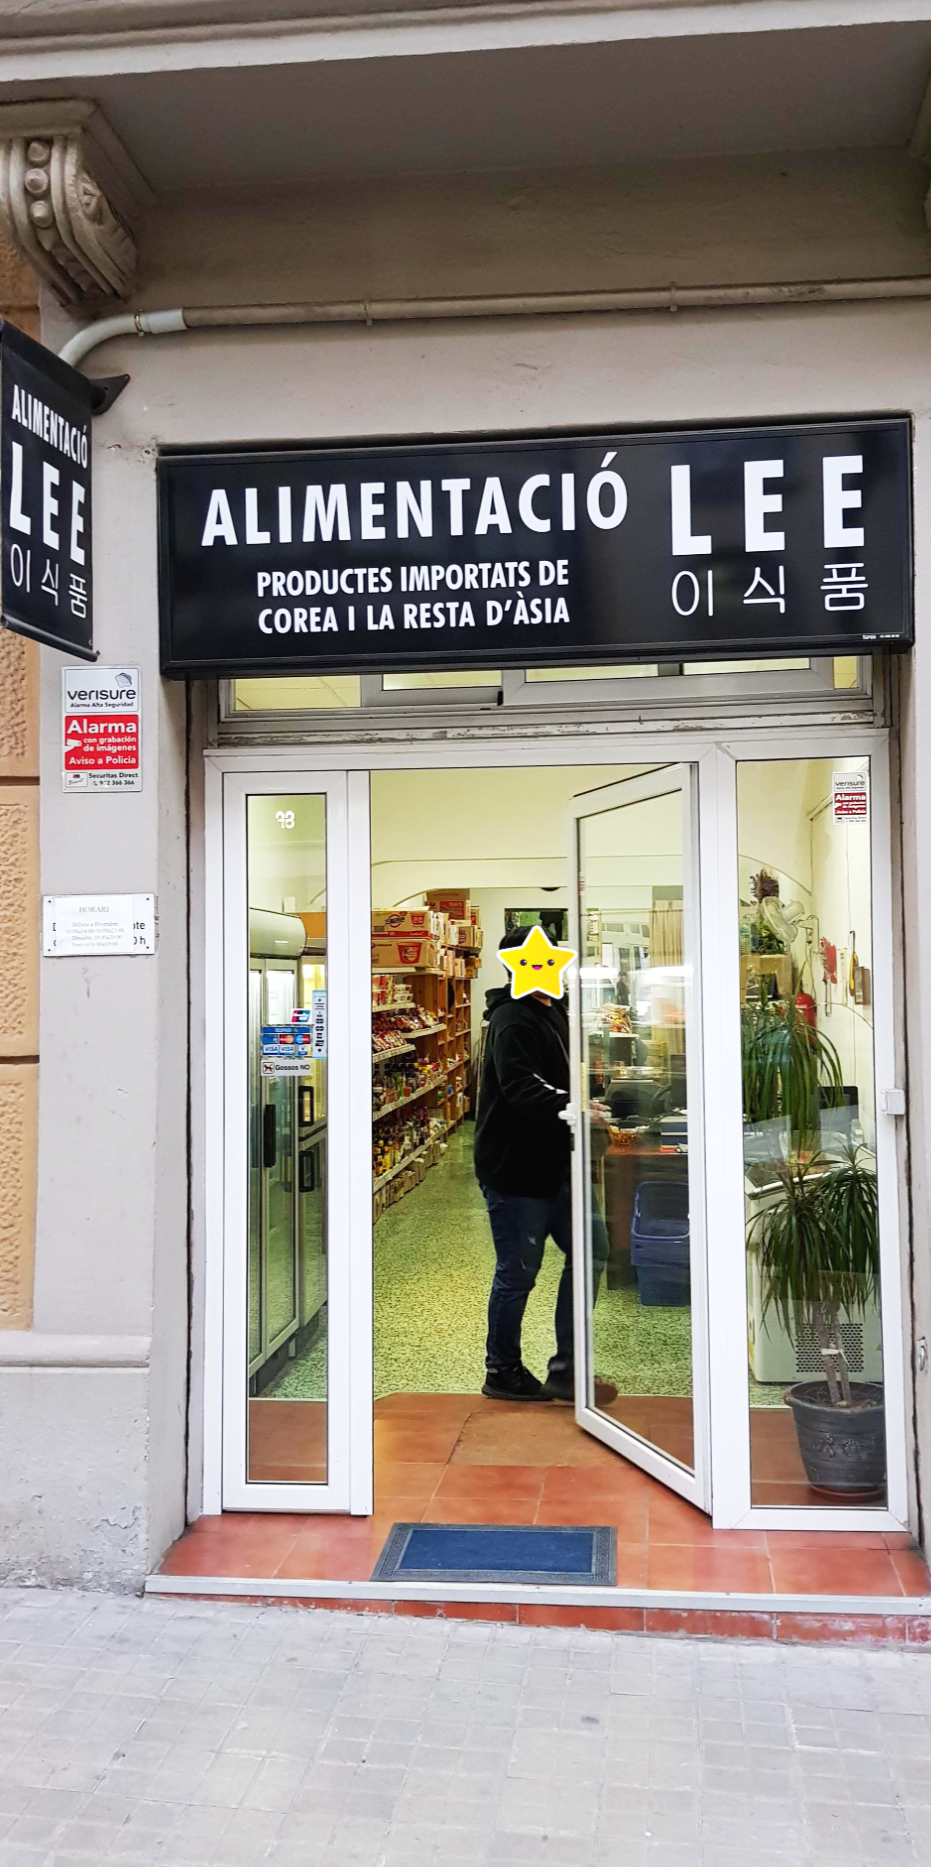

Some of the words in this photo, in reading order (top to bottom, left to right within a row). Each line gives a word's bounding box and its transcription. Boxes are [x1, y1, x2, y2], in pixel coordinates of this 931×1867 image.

[11, 384, 88, 469] ALIMENTACIÓ
[9, 441, 86, 566] LEE
[201, 451, 628, 546] ALIMENTACIÓ
[670, 454, 865, 556] LEE
[257, 566, 392, 597] PRODUCTES
[400, 560, 531, 592] IMPORTATS
[538, 559, 570, 586] DE
[258, 607, 339, 634] COREA
[347, 606, 355, 631] I
[367, 604, 395, 631] LA
[403, 600, 476, 629] RESTA
[67, 689, 136, 700] verisure
[67, 719, 137, 734] Alarma
[99, 735, 136, 745] grabación
[69, 757, 95, 765] Aviso
[97, 757, 103, 765] a
[105, 755, 136, 765] Policía
[83, 744, 94, 752] de
[96, 743, 136, 753] imágenes
